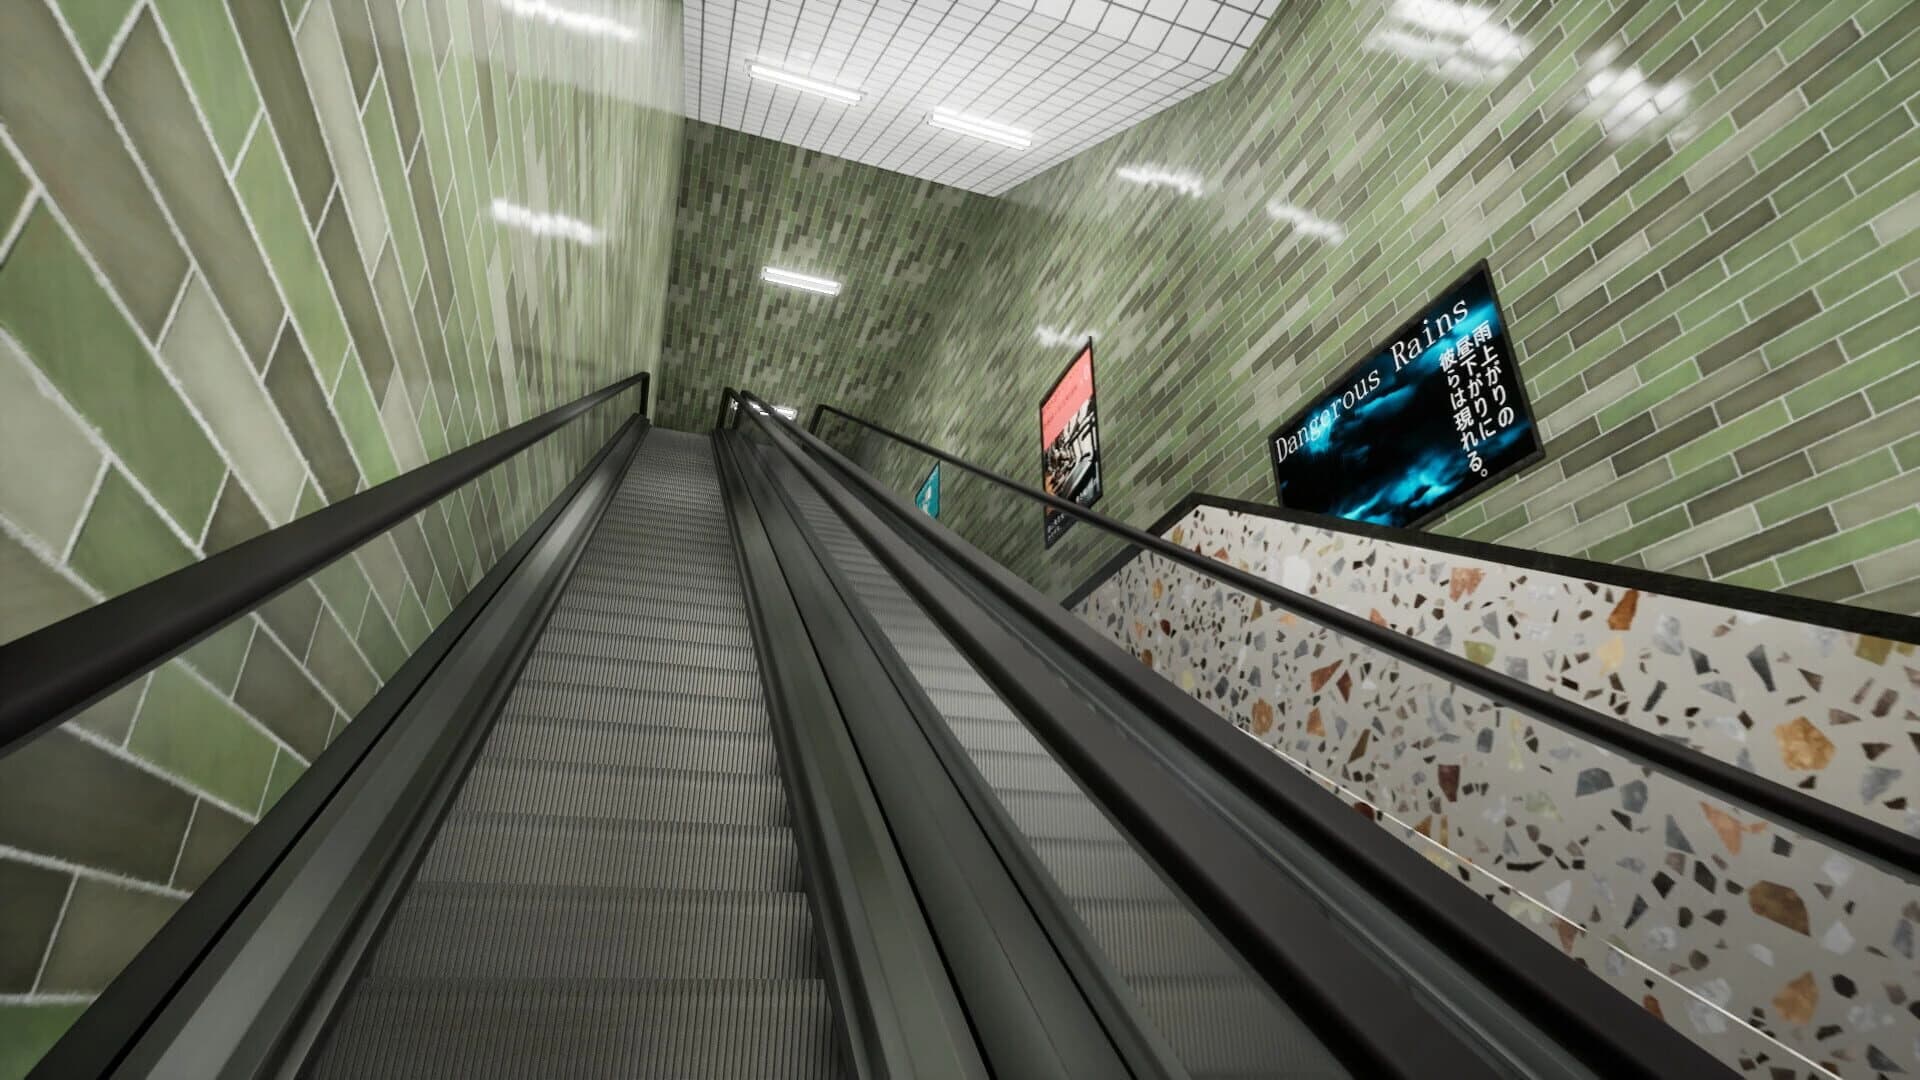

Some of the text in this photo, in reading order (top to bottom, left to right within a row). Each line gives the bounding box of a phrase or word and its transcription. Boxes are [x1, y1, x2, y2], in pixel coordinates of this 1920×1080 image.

[1274, 300, 1469, 464] Dangerous Rains
[1439, 347, 1488, 477] 彼らは現れる。
[1456, 335, 1497, 441] 昼下がりに
[1472, 320, 1515, 428] 雨上がりの
